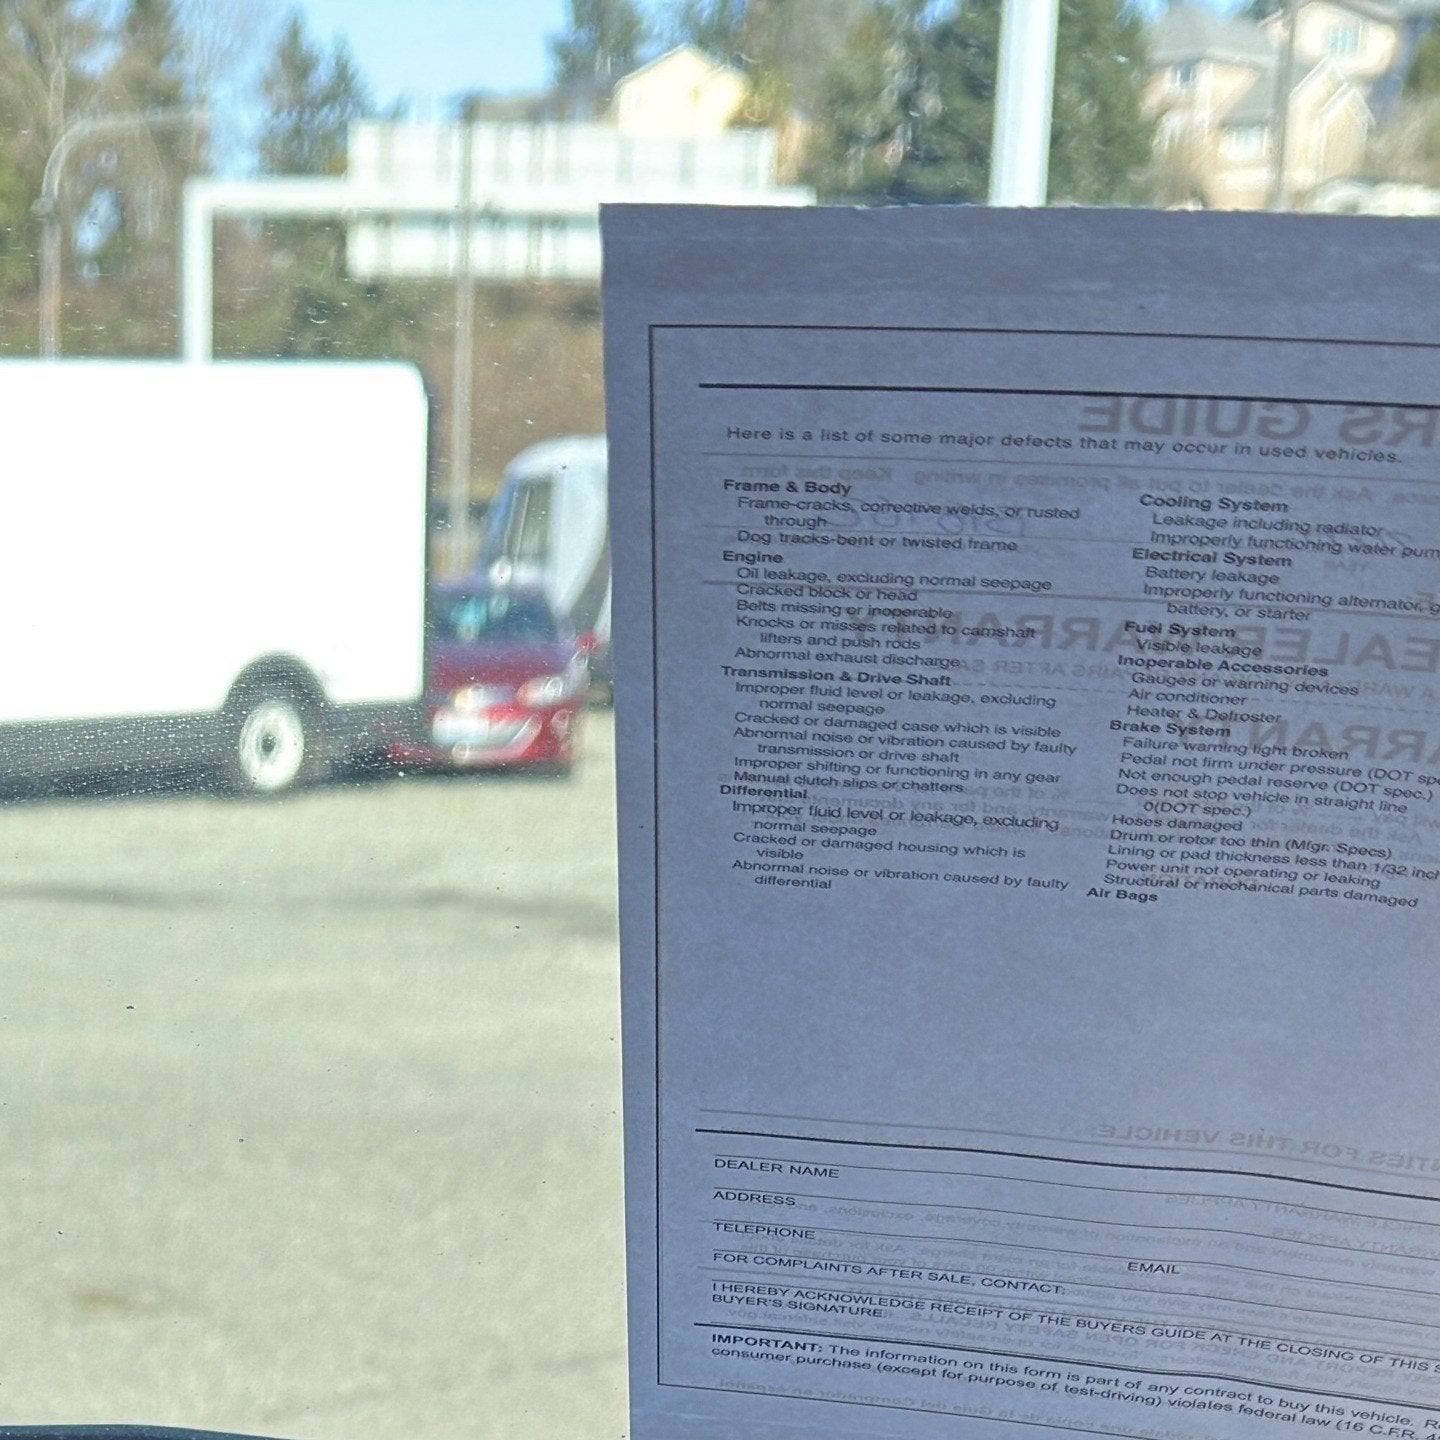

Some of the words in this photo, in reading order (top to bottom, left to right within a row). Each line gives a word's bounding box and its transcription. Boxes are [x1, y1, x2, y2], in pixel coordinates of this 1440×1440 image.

[727, 426, 772, 441] Here
[778, 428, 796, 441] is
[802, 432, 813, 441] a
[821, 428, 849, 443] list
[855, 429, 874, 443] of
[881, 434, 931, 445] some
[939, 433, 992, 449] major
[1001, 433, 1072, 449] defects
[1080, 437, 1118, 450] that
[1125, 441, 1164, 454] may
[1173, 443, 1225, 454] occur
[1235, 442, 1251, 456] in
[1259, 444, 1306, 459] used
[1316, 447, 1402, 464] vehicles.
[724, 480, 781, 493] Frame
[787, 481, 799, 494] &
[805, 481, 852, 496] Body
[1140, 493, 1212, 511] Cooling
[1219, 496, 1288, 513] System
[723, 551, 783, 565] Engine
[1133, 548, 1217, 564] Electrical
[1224, 552, 1292, 568] System
[737, 567, 760, 580] Oil
[765, 568, 832, 584] leakage,
[837, 571, 914, 587] excluding
[920, 574, 975, 587] normal
[980, 578, 1051, 591] seepage
[1145, 567, 1206, 582] Battery
[1212, 569, 1279, 585] leakage
[1124, 621, 1161, 635] Fuel
[1168, 623, 1235, 639] System
[1118, 655, 1212, 673] Inoperable
[1219, 660, 1328, 677] Accessories
[722, 666, 835, 683] Transmission
[841, 671, 852, 683] &
[858, 671, 902, 685] Drive
[908, 672, 950, 687] Shaft
[1129, 688, 1158, 700] Air
[1157, 690, 1247, 707] conditioner
[735, 712, 799, 727] Cracked
[804, 717, 819, 727] or
[825, 716, 896, 732] damaged
[902, 721, 940, 733] case
[944, 722, 988, 735] which
[995, 724, 1007, 736] is
[1012, 724, 1060, 738] visible
[1110, 720, 1160, 734] Brake
[1167, 722, 1230, 738] System
[720, 785, 808, 799] Differential
[1112, 815, 1162, 827] Hoses
[1168, 817, 1242, 833] damaged
[1087, 888, 1111, 899] Air
[1115, 889, 1157, 904] Bags
[714, 1159, 782, 1173] DEALER
[790, 1164, 839, 1178] NAME
[713, 1191, 796, 1206] ADDRESS
[713, 1222, 815, 1240] TELEPHONE
[713, 1252, 748, 1264] FOR
[753, 1255, 862, 1275] COMPLAINTS
[868, 1266, 922, 1281] AFTER
[928, 1272, 975, 1287] SALE,
[981, 1278, 1067, 1295] CONTACT:
[1128, 1262, 1180, 1275] EMAIL
[712, 1294, 782, 1308] BUYER'S
[788, 1300, 883, 1318] SIGNATURE
[713, 1282, 718, 1293] I
[723, 1283, 789, 1297] HEREBY
[794, 1290, 925, 1310] ACKNOWLEDGE
[932, 1301, 1004, 1318] RECEIPT
[1010, 1308, 1032, 1321] OF
[1038, 1312, 1070, 1326] THE
[1077, 1316, 1144, 1335] BUYERS
[1152, 1325, 1205, 1339] GUIDE
[1211, 1333, 1232, 1344] AT
[1239, 1335, 1272, 1350] THE
[1277, 1341, 1354, 1363] CLOSING
[1360, 1354, 1383, 1365] OF
[1389, 1358, 1428, 1372] THIS
[712, 1334, 822, 1353] IMPORTANT:
[829, 1344, 860, 1357] The
[866, 1347, 958, 1370] information
[963, 1358, 983, 1370] on
[990, 1360, 1018, 1374] this
[1024, 1365, 1062, 1380] form
[1066, 1369, 1081, 1382] is
[1086, 1374, 1119, 1391] part
[1126, 1378, 1144, 1389] of
[1149, 1382, 1178, 1397] any
[1184, 1385, 1250, 1403] contract
[1256, 1390, 1273, 1404] to
[1278, 1394, 1309, 1414] buy
[1315, 1400, 1345, 1416] this
[1351, 1409, 1412, 1427] vehicle.
[712, 1350, 791, 1362] consumer
[796, 1354, 871, 1375] purchase
[877, 1360, 932, 1381] (except
[938, 1368, 963, 1382] for
[968, 1373, 1034, 1392] purpose
[1041, 1379, 1059, 1392] of
[1065, 1383, 1163, 1408] test-driving)
[1168, 1399, 1233, 1413] violates
[1238, 1404, 1296, 1423] federal
[1302, 1412, 1329, 1428] law
[1335, 1418, 1363, 1435] (16
[1369, 1423, 1420, 1440] C.F.R.
